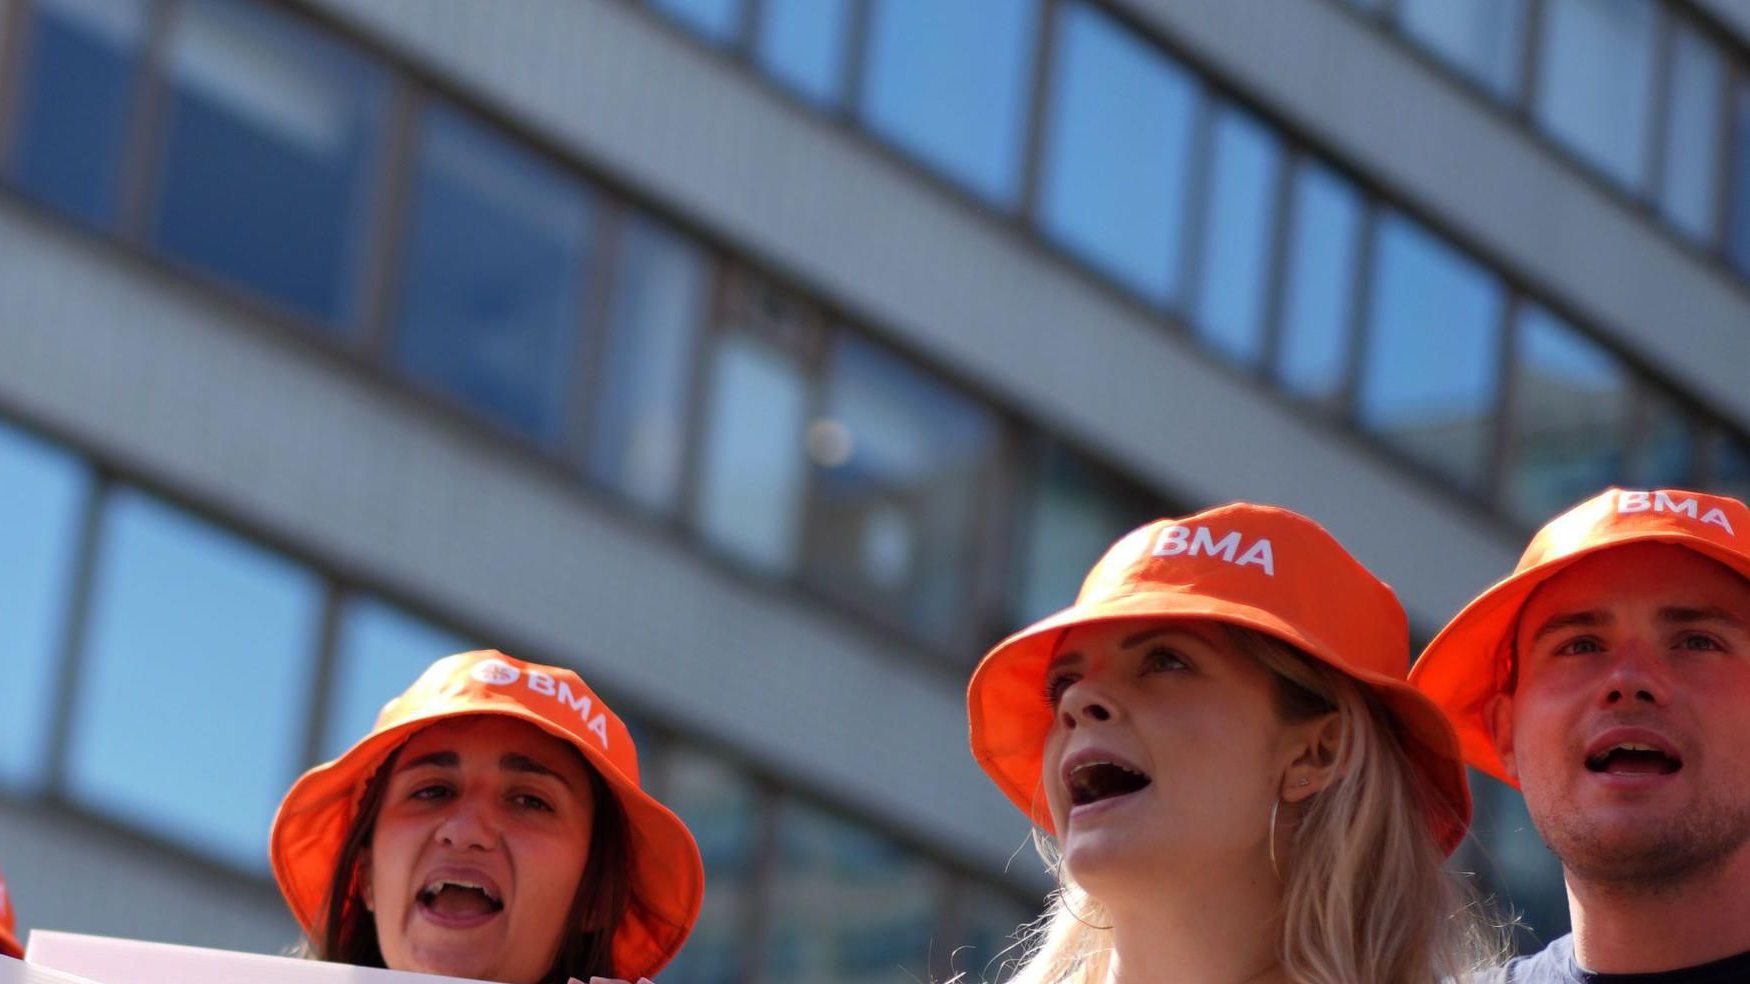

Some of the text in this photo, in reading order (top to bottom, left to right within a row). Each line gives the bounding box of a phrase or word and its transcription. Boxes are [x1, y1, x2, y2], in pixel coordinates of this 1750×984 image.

[1618, 491, 1735, 537] BMA
[1152, 526, 1275, 577] BMA
[527, 670, 608, 750] BMA
